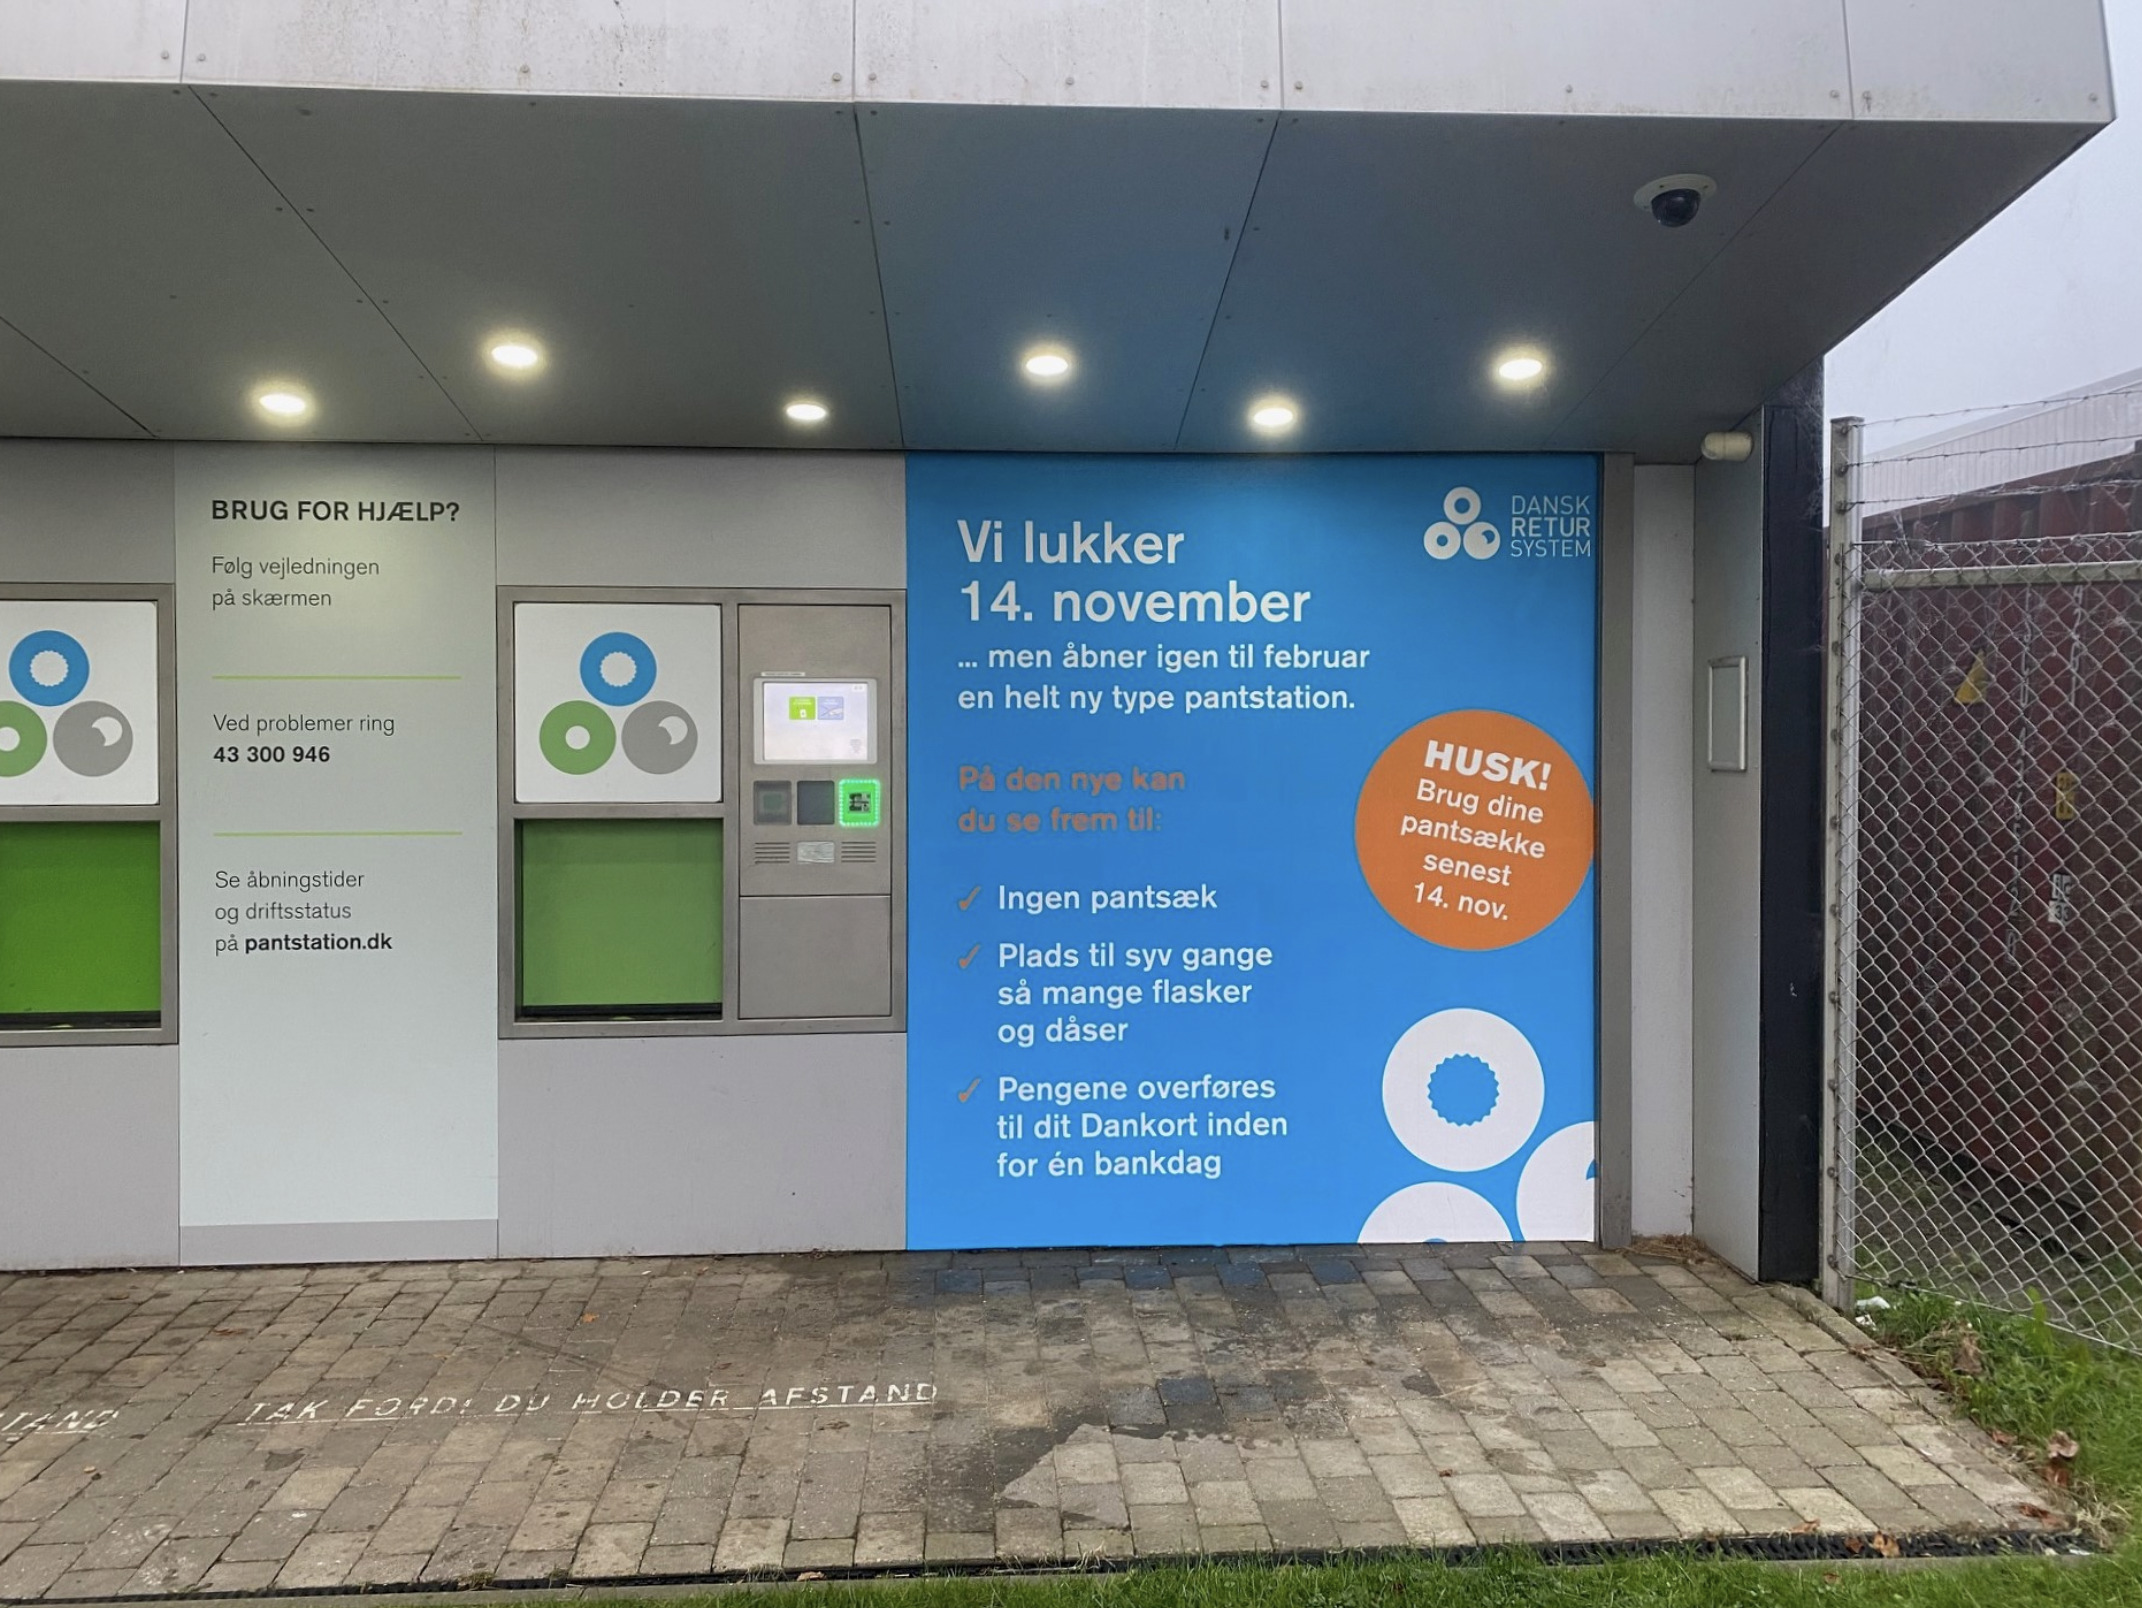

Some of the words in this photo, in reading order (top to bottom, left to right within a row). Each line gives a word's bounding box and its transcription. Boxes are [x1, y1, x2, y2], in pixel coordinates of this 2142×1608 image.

[212, 500, 288, 521] BRUG
[298, 501, 348, 520] FOR
[359, 502, 459, 521] HJÆLP?
[1512, 495, 1589, 514] DANSK
[1512, 517, 1589, 537] RETUR
[958, 520, 1002, 562] Vi
[1026, 521, 1184, 564] lukker
[1511, 540, 1590, 557] SYSTEM
[213, 556, 252, 579] Følg
[259, 557, 379, 579] vejledningen
[213, 589, 235, 610] på
[242, 589, 331, 606] skærmen
[962, 581, 1032, 621] 14.
[1055, 580, 1310, 622] november
[989, 650, 1051, 668] men
[1063, 642, 1146, 668] åbner
[1158, 644, 1217, 672] igen
[1229, 644, 1253, 668] til
[1264, 644, 1369, 668] februar
[959, 691, 993, 708] en
[1006, 685, 1059, 708] helt
[1071, 691, 1102, 714] ny
[1112, 686, 1174, 713] type
[1186, 685, 1354, 713] pantstation.
[214, 714, 249, 731] Ved
[257, 714, 352, 736] problemer
[360, 714, 394, 736] ring
[213, 746, 239, 763] 43
[248, 747, 284, 762] 300
[293, 746, 329, 762] 946
[1424, 740, 1551, 791] HUSK!
[960, 766, 995, 790] På
[1006, 768, 1060, 790] den
[1072, 773, 1121, 795] nye
[1133, 768, 1184, 790] kan
[1417, 779, 1479, 814] Brug
[1488, 795, 1543, 823] dine
[959, 809, 995, 832] du
[1007, 814, 1040, 831] se
[1051, 808, 1117, 831] frem
[1128, 808, 1162, 832] til:
[1401, 813, 1545, 859] pantsække
[216, 871, 240, 888] Se
[248, 871, 364, 892] åbningstider
[1423, 855, 1511, 886] senest
[215, 907, 238, 924] og
[246, 902, 351, 919] driftsstatus
[1000, 886, 1079, 914] Ingen
[1092, 884, 1217, 913] pantsæk
[1415, 883, 1447, 908] 14.
[1458, 896, 1507, 920] nov.
[216, 934, 238, 956] på
[246, 933, 392, 954] pantstation.dk
[1000, 943, 1078, 967] Plads
[1089, 943, 1113, 966] til
[1126, 949, 1171, 971] syv
[1183, 948, 1272, 971] gange
[999, 979, 1030, 1005] så
[1043, 986, 1142, 1009] mange
[1153, 979, 1252, 1003] flasker
[998, 1024, 1034, 1047] og
[1046, 1016, 1128, 1042] dåser
[1000, 1077, 1127, 1105] Pengene
[1139, 1074, 1275, 1099] overføres
[997, 1115, 1022, 1139] til
[1035, 1114, 1070, 1138] dit
[1082, 1113, 1197, 1137] Dankort
[1209, 1112, 1286, 1135] inden
[997, 1153, 1038, 1177] for
[1049, 1152, 1083, 1176] én
[1096, 1150, 1220, 1178] bankdag
[242, 1400, 327, 1422] TAK
[494, 1393, 550, 1412] DU
[572, 1390, 729, 1409] HOLDER
[759, 1383, 938, 1405] AFSTAND
[0, 1410, 119, 1431] TAND
